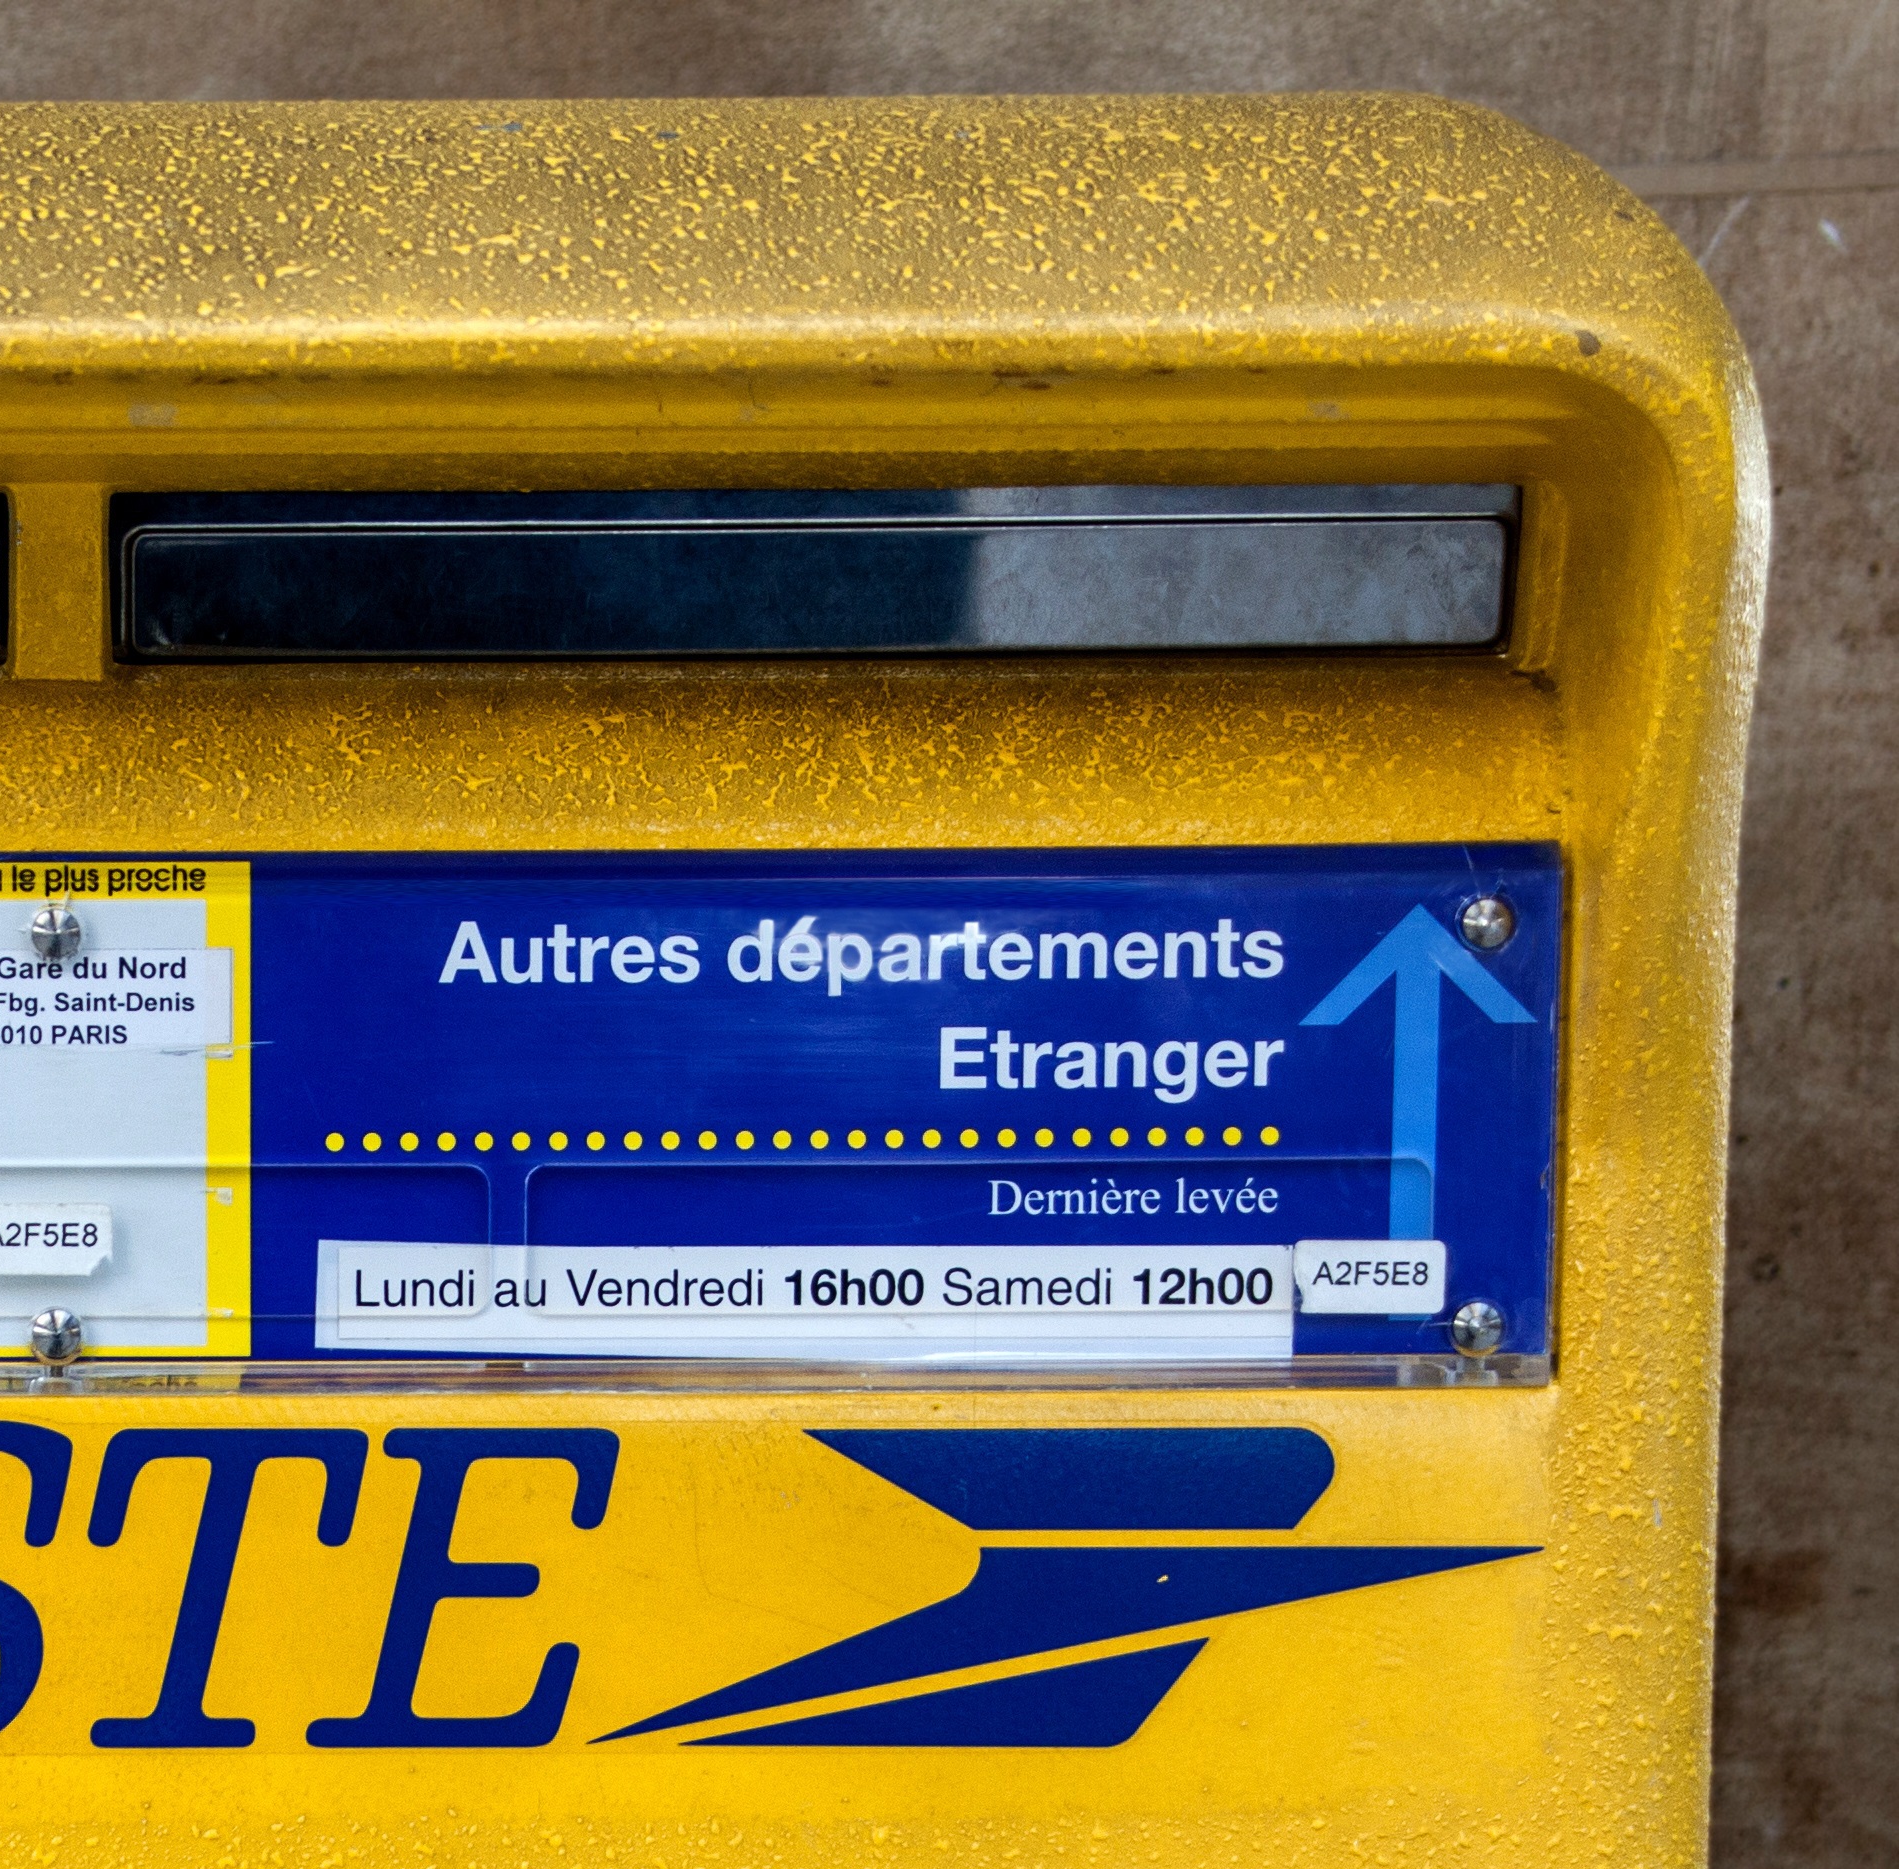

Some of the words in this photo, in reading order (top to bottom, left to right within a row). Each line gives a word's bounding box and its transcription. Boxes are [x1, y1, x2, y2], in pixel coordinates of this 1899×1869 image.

[11, 864, 36, 892] le
[44, 864, 100, 896] plus
[107, 864, 207, 896] proche
[72, 956, 107, 980] du
[118, 956, 187, 980] Nord
[438, 920, 700, 984] Autres
[727, 917, 1284, 997] départements
[53, 993, 195, 1012] Saint-Denis
[51, 1025, 128, 1045] PARIS
[938, 1026, 1285, 1104] Etranger
[988, 1178, 1160, 1216] Dernière
[1175, 1178, 1279, 1216] levée
[355, 1269, 474, 1307] Lundi
[494, 1278, 547, 1307] au
[566, 1268, 764, 1307] Vendredi
[785, 1268, 924, 1307] 16h00
[942, 1268, 1112, 1307] Samedi
[1133, 1268, 1273, 1305] 12h00
[1313, 1261, 1429, 1286] A2F5E8
